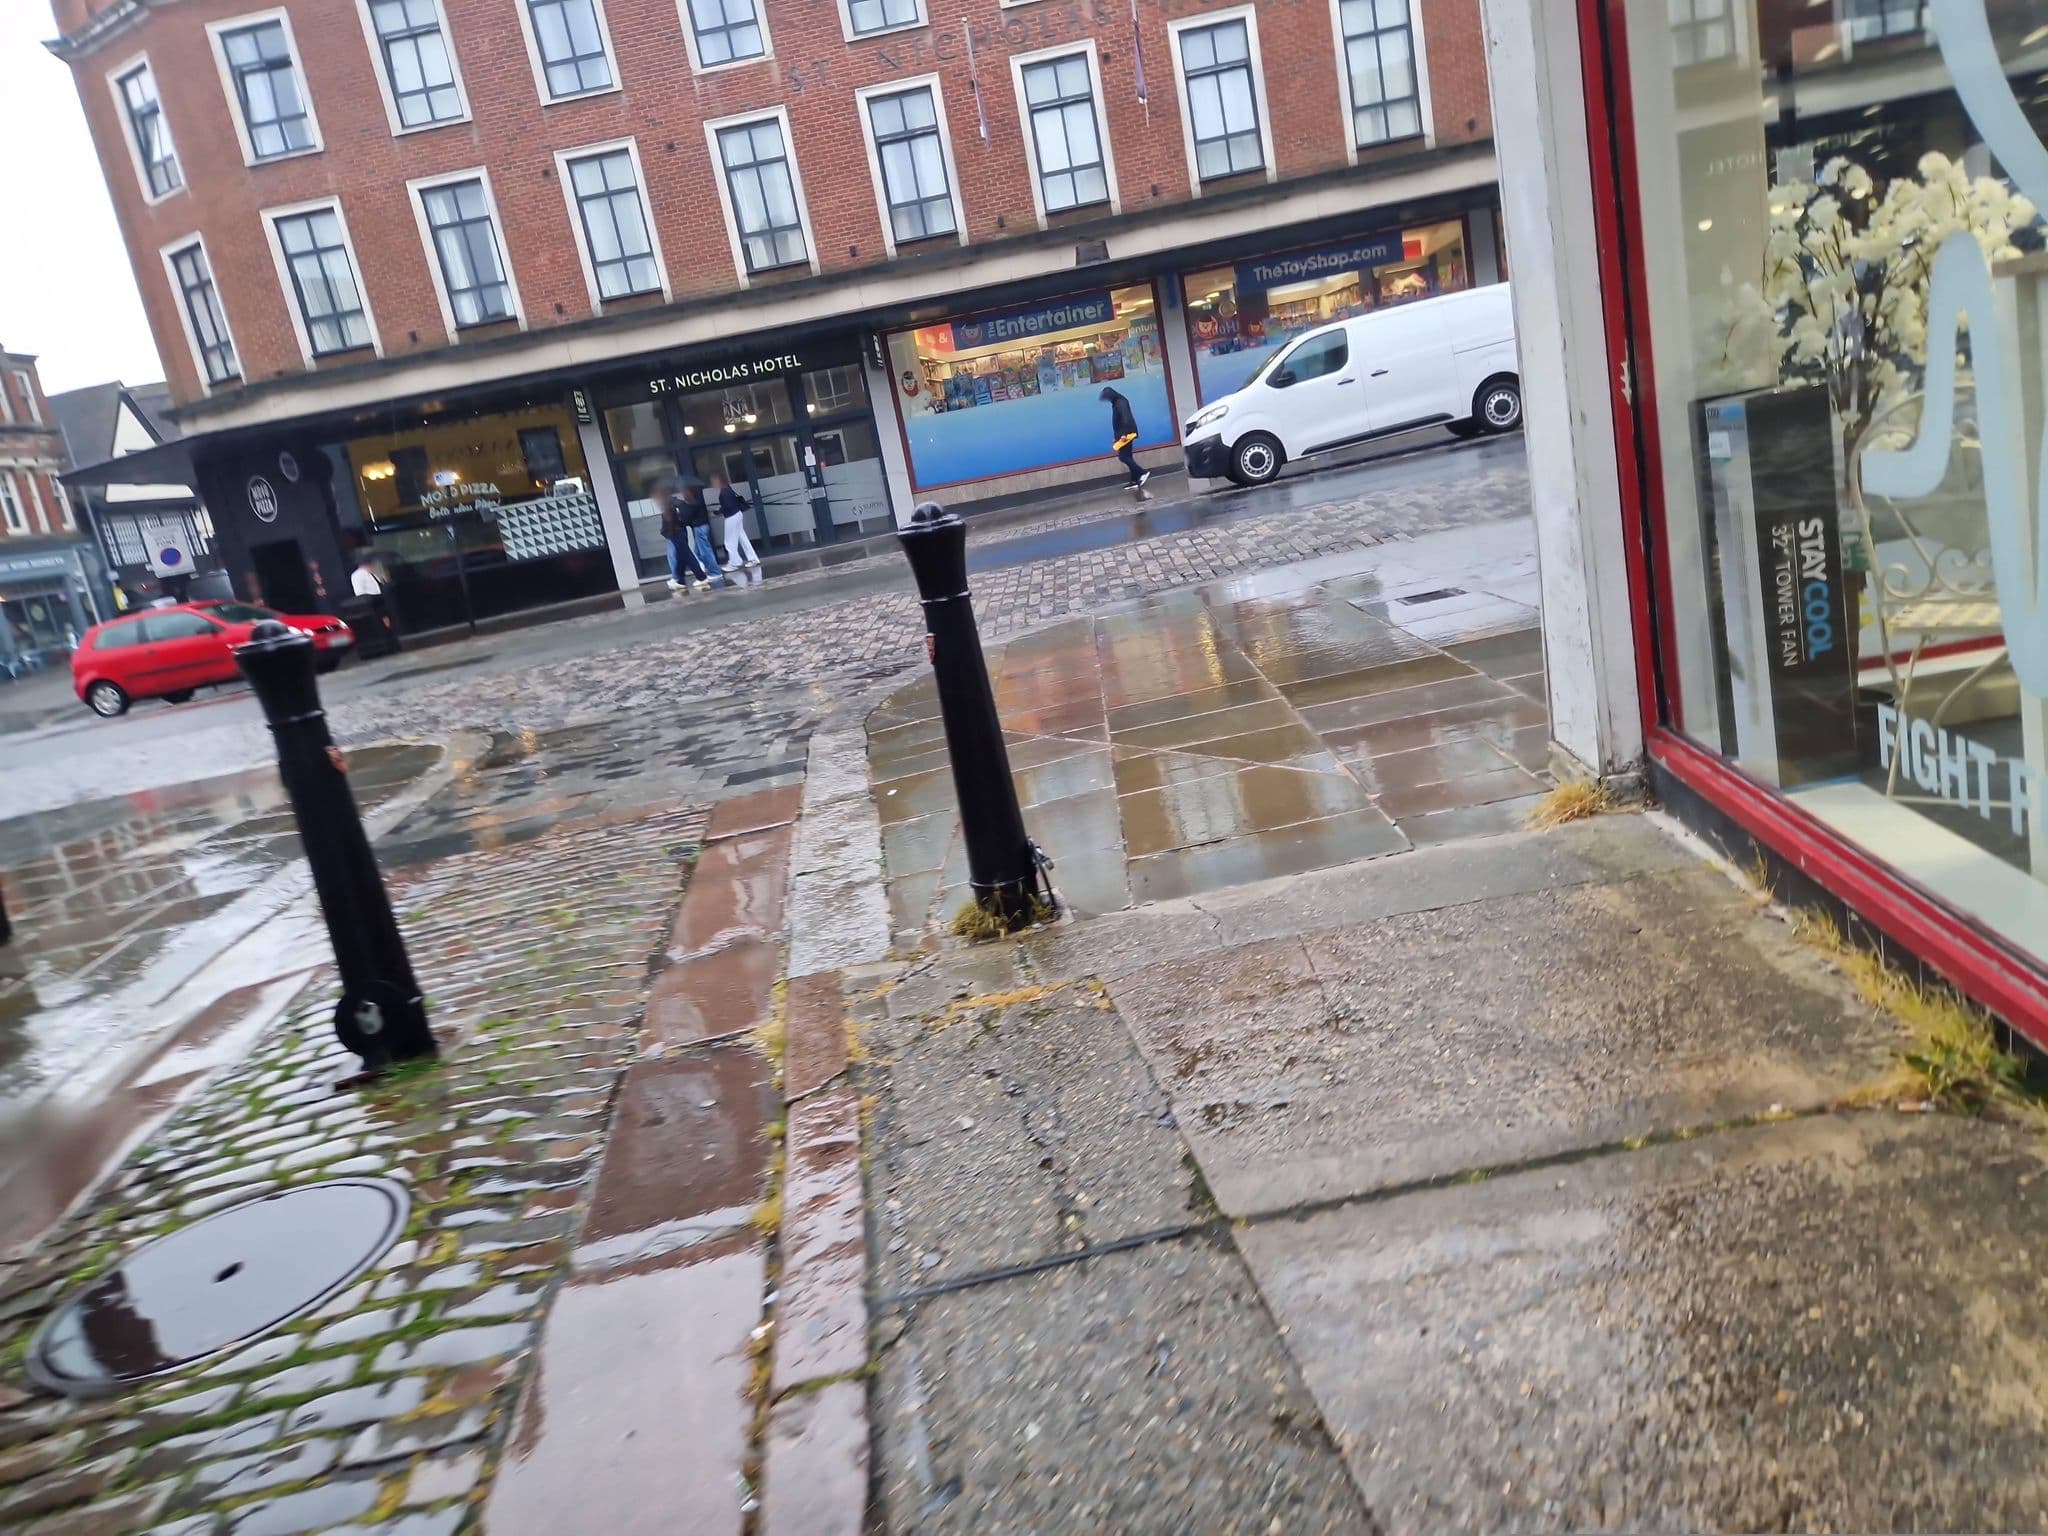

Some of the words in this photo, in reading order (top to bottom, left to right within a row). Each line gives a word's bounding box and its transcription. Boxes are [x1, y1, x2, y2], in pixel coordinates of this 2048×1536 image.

[1253, 245, 1388, 282] TheToyShop.com
[997, 301, 1105, 335] Entertainer
[650, 379, 672, 393] ST.
[675, 364, 749, 388] NICHOLAS
[753, 354, 801, 374] HOTEL
[460, 482, 500, 496] PIZZA
[1775, 560, 1795, 626] TOWER
[1799, 517, 1833, 662] STAYCOOL
[1780, 630, 1799, 668] FAN
[1877, 703, 1997, 820] FIGHT
[2009, 757, 2048, 846] F
